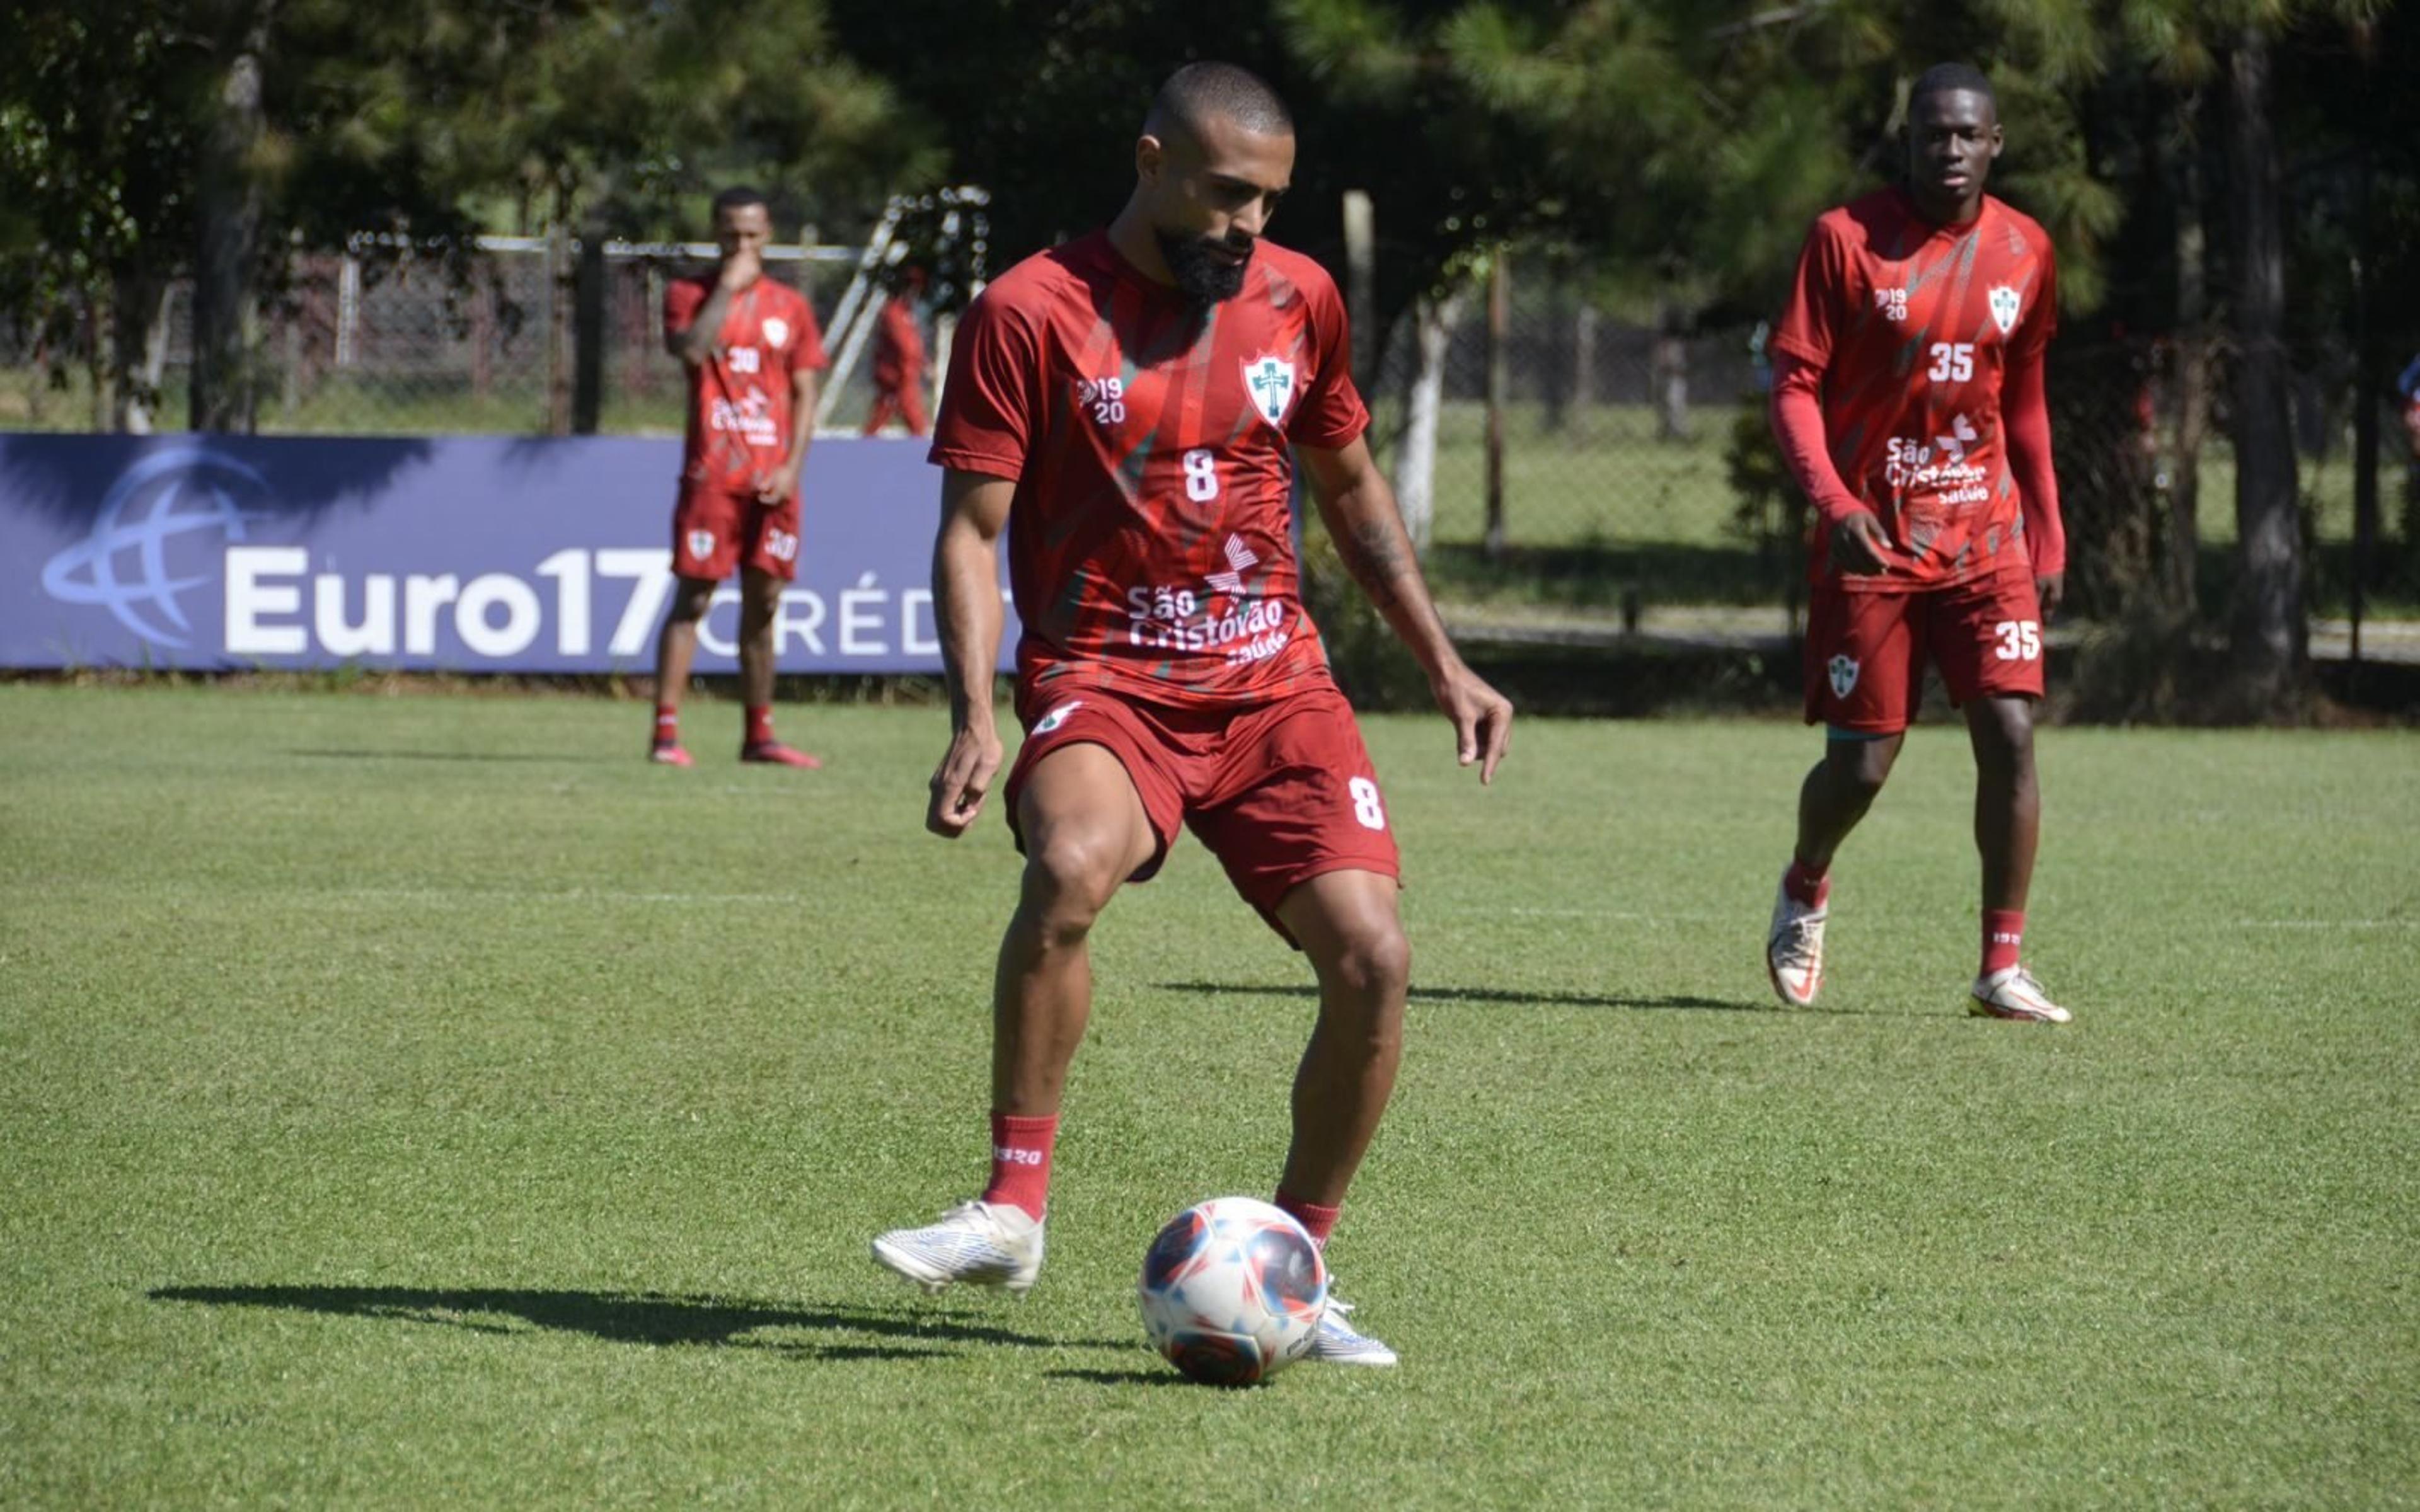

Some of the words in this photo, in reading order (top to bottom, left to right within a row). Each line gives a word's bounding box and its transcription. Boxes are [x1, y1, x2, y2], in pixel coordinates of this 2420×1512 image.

[1886, 304, 1907, 321] 20
[1889, 287, 1906, 305] 19
[728, 346, 760, 374] 30
[1928, 341, 1974, 382] 35
[1098, 377, 1122, 400] 19
[1095, 401, 1125, 424] 20
[1887, 437, 1930, 464] São
[1183, 449, 1219, 502] 8
[764, 528, 797, 561] 30
[226, 547, 673, 657] Euro17
[1127, 585, 1196, 619] São
[1995, 621, 2041, 660] 35
[1349, 776, 1385, 830] 8
